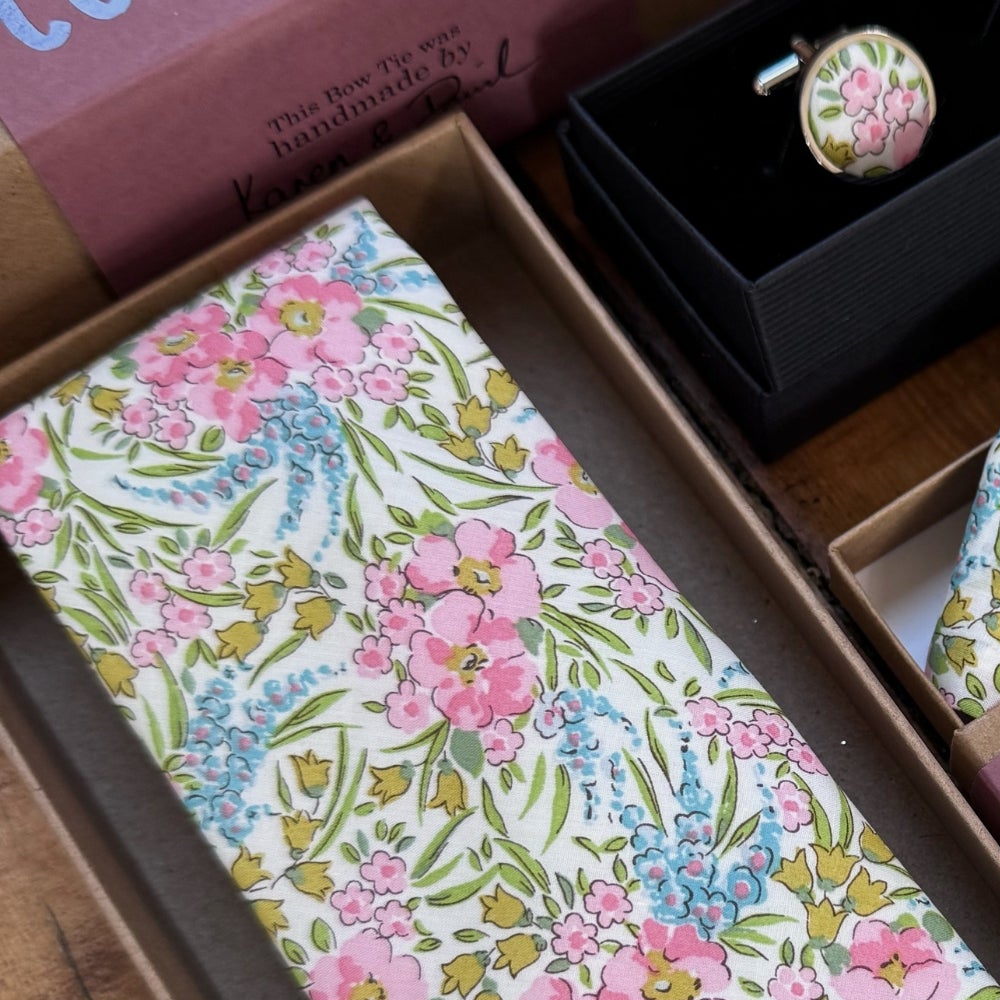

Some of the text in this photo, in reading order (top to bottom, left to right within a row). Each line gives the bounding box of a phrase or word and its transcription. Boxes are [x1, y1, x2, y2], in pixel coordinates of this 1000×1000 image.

[268, 24, 461, 136] This Bow Tie was
[269, 41, 470, 158] handmade by
